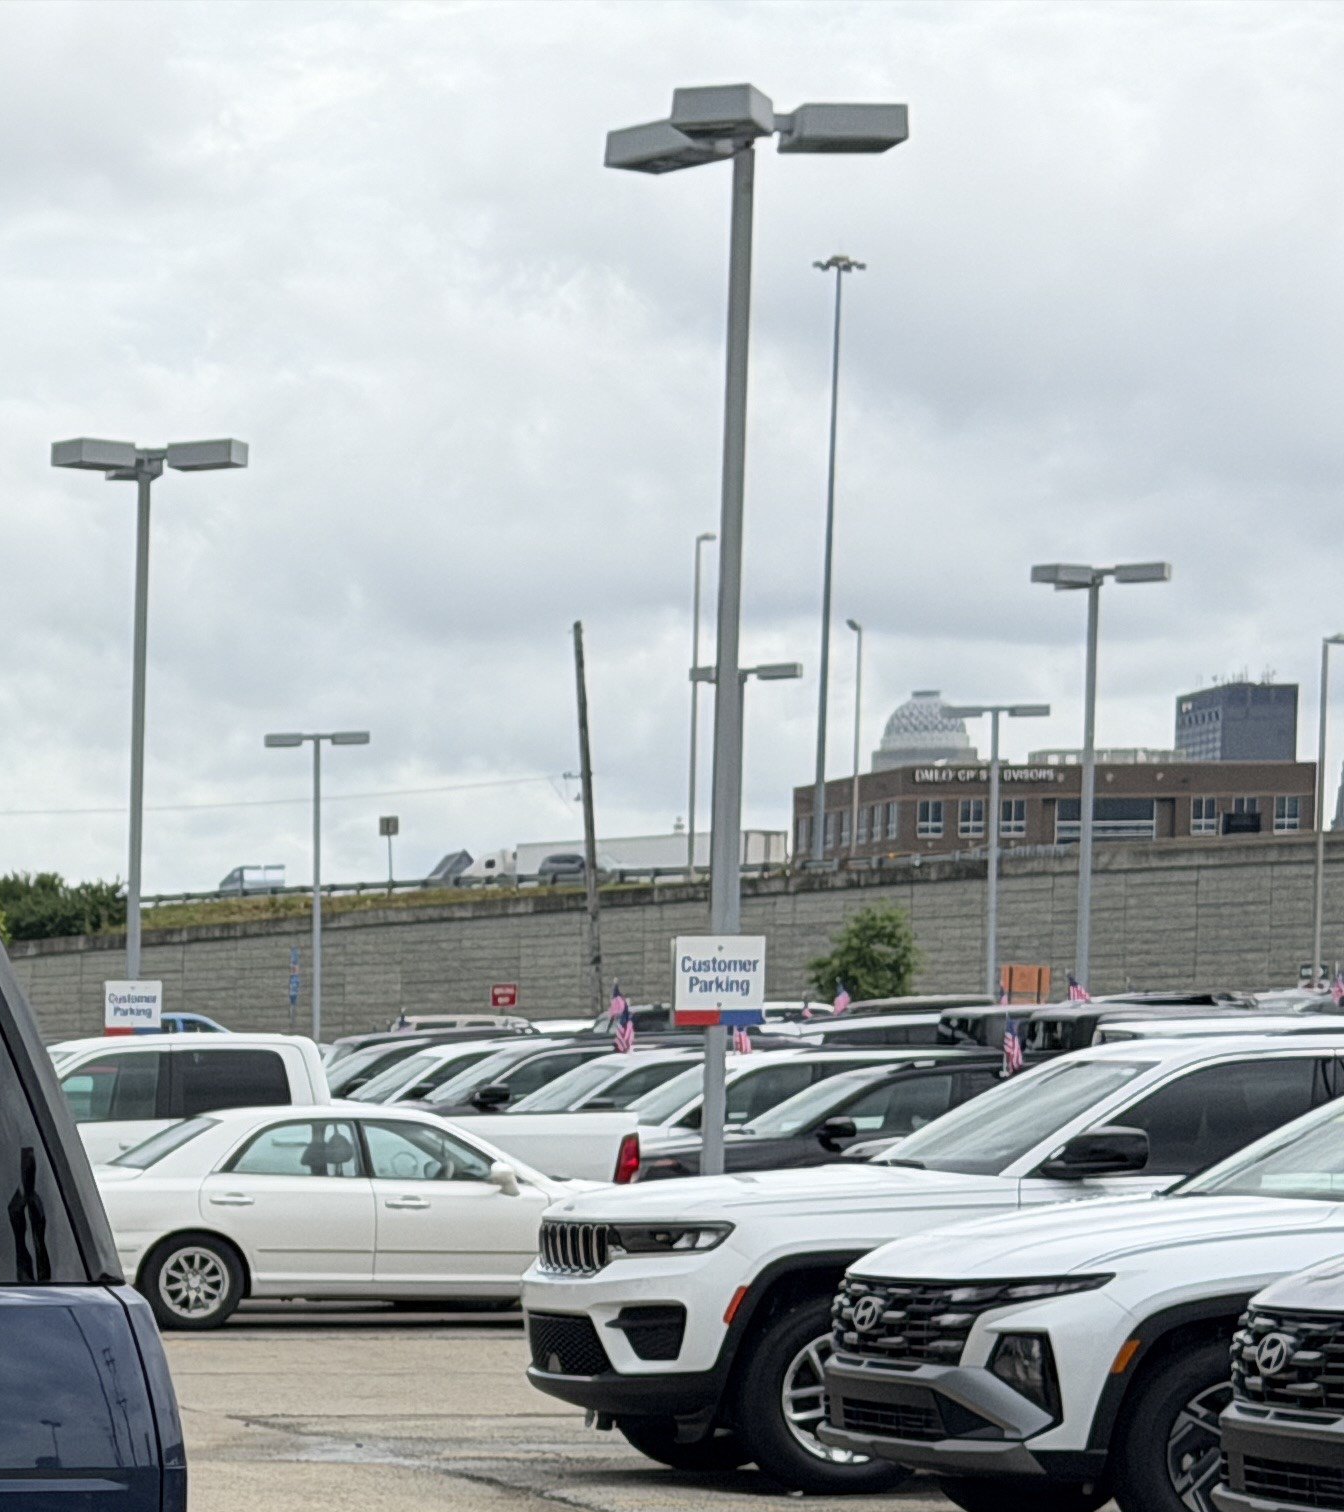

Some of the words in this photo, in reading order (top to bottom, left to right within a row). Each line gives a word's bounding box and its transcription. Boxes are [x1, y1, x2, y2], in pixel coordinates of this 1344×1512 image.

[998, 768, 1054, 782] DVISORS
[681, 955, 760, 973] Customer
[688, 975, 751, 997] Parking
[108, 992, 157, 1004] Customer
[113, 1006, 152, 1019] Parking
